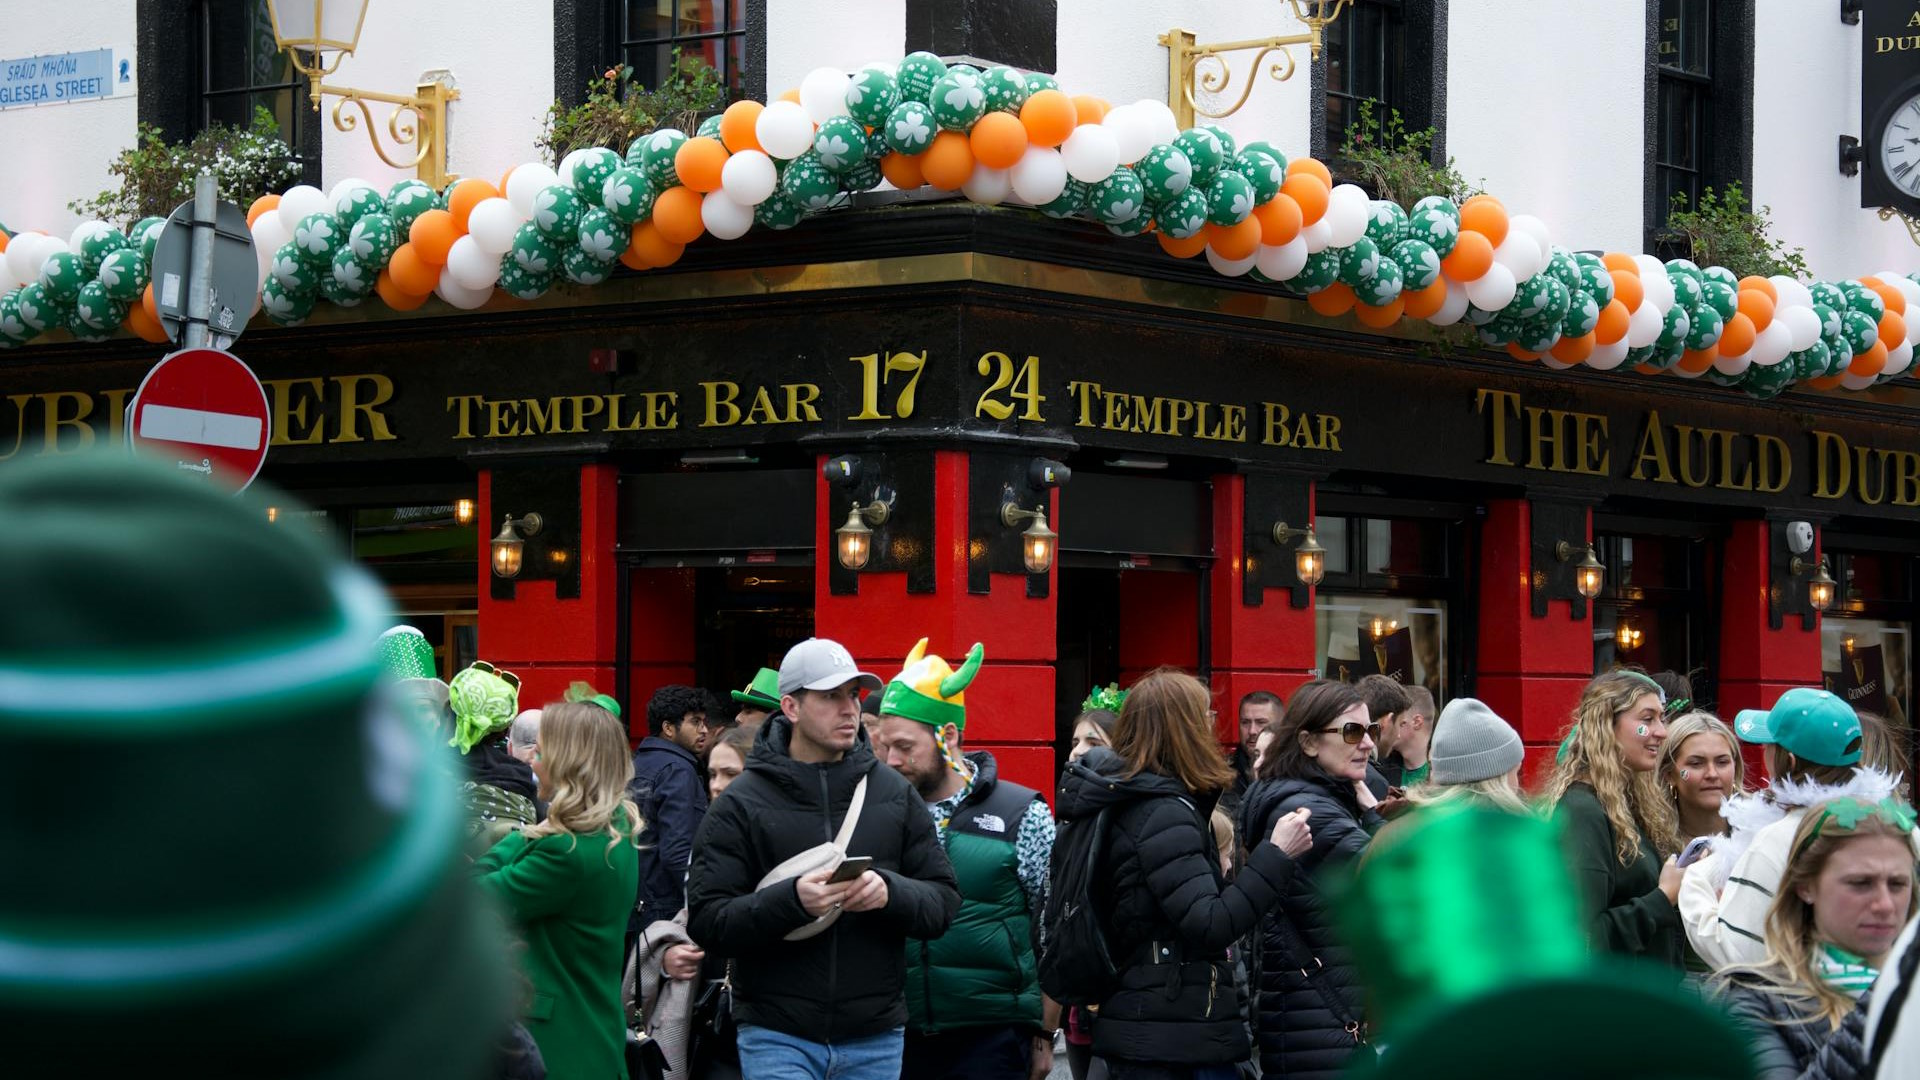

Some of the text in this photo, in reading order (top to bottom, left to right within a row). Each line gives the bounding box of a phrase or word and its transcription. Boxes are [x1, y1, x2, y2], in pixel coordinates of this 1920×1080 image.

[7, 57, 77, 81] SRÁID MHÓNA
[56, 77, 103, 98] STREET
[119, 58, 130, 83] 2
[446, 381, 822, 439] TEMPLE BAR
[848, 350, 927, 420] 17
[975, 351, 1047, 423] 24
[1068, 380, 1343, 452] TEMPLE BAR
[1476, 388, 1920, 507] THE AULD DUB
